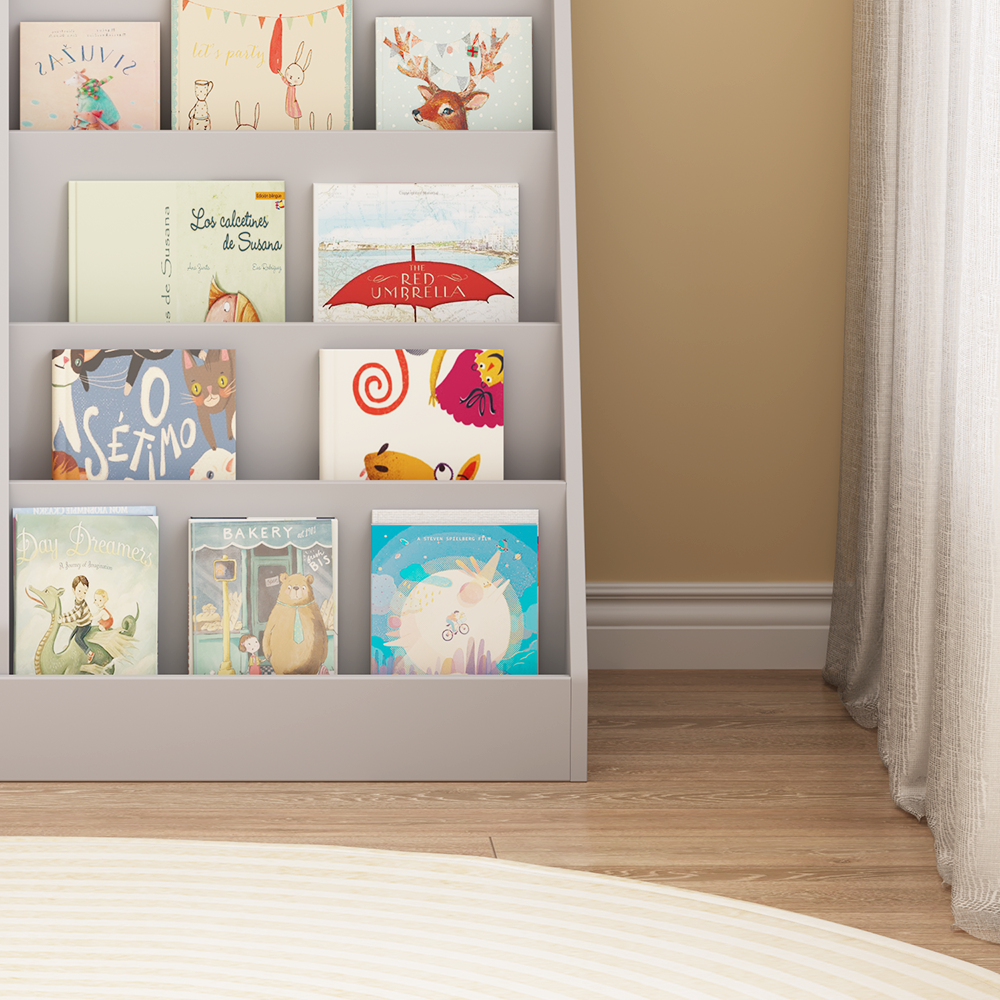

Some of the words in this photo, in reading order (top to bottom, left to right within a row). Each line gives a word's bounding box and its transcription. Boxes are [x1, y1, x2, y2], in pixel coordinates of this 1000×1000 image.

[192, 42, 222, 59] let's
[225, 44, 266, 69] party
[190, 207, 216, 231] Los
[220, 210, 269, 228] calcetines
[161, 206, 172, 278] Susana
[223, 233, 235, 250] de
[238, 231, 282, 252] Susana
[401, 273, 434, 286] RED
[161, 284, 170, 305] de
[371, 286, 466, 301] UMBRELLA
[140, 366, 170, 427] O
[17, 527, 58, 566] Day
[66, 521, 152, 567] Dreamers
[223, 526, 293, 540] BAKERY
